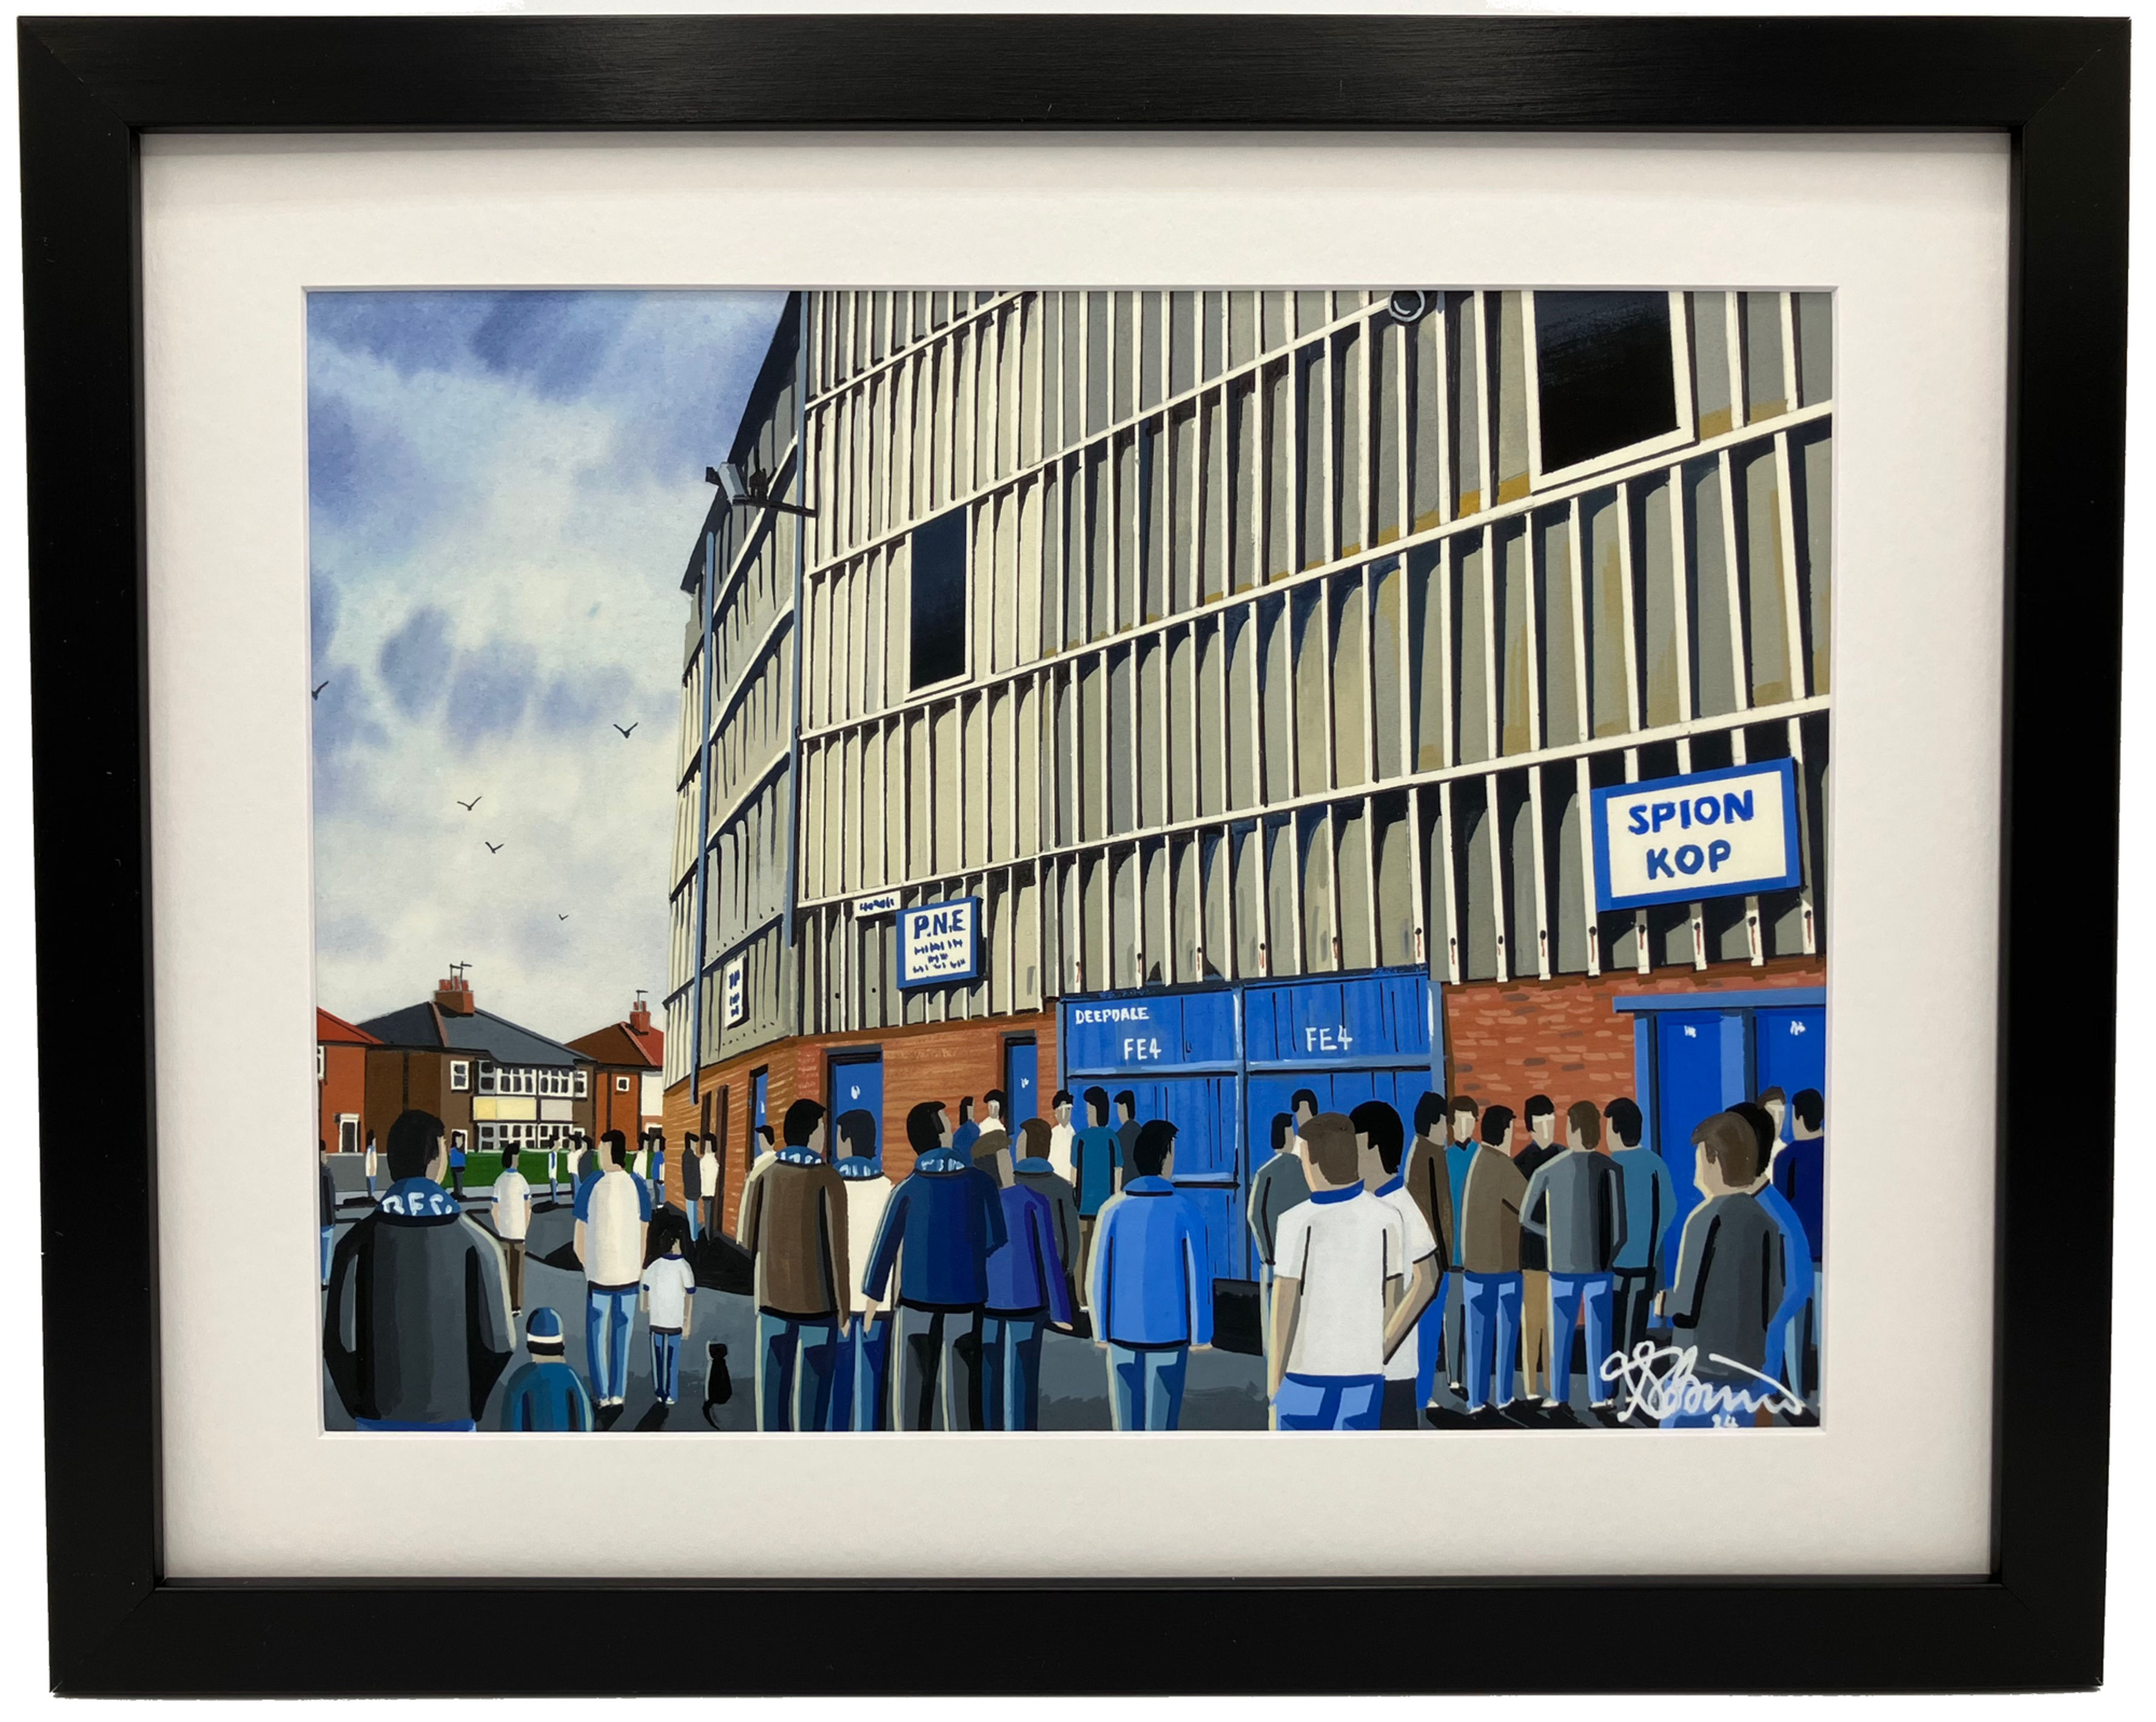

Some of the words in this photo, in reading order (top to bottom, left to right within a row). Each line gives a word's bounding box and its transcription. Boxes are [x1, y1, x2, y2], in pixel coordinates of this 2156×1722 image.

[1628, 789, 1754, 835] SPION
[1646, 839, 1731, 880] KOP
[1075, 1007, 1150, 1025] DEEPDALE
[1124, 1038, 1162, 1060] FE4
[1305, 1025, 1353, 1052] FE4
